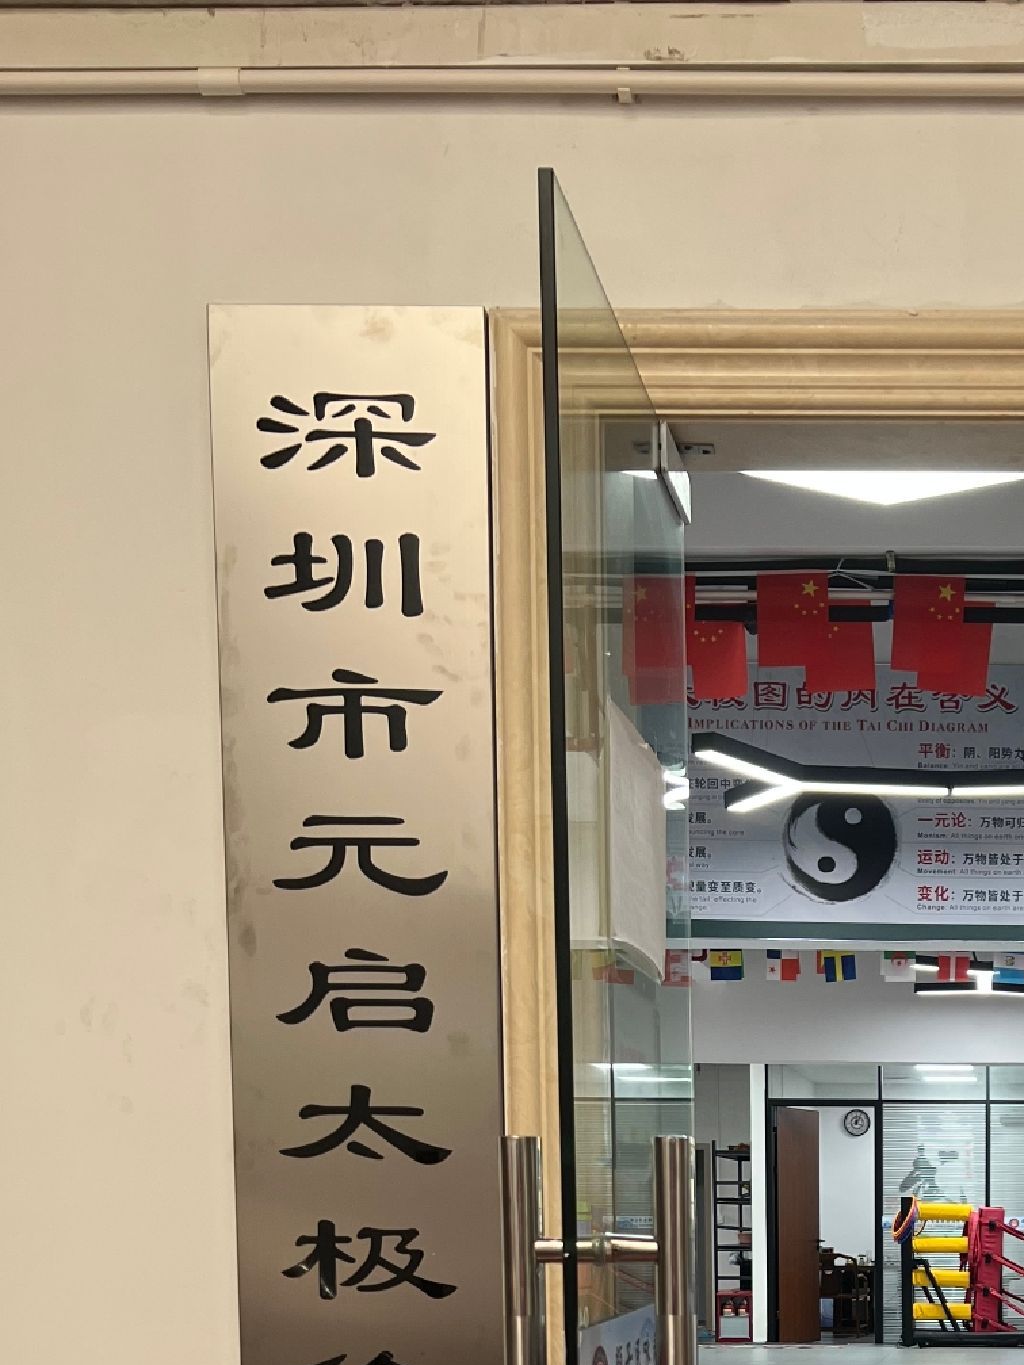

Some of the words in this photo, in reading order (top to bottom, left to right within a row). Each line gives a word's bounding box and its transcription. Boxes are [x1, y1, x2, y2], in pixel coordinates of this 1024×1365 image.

[688, 718, 795, 731] IMPLICATIONS
[798, 719, 817, 731] OF
[823, 719, 852, 732] THE
[919, 720, 989, 734] DIAGRAM
